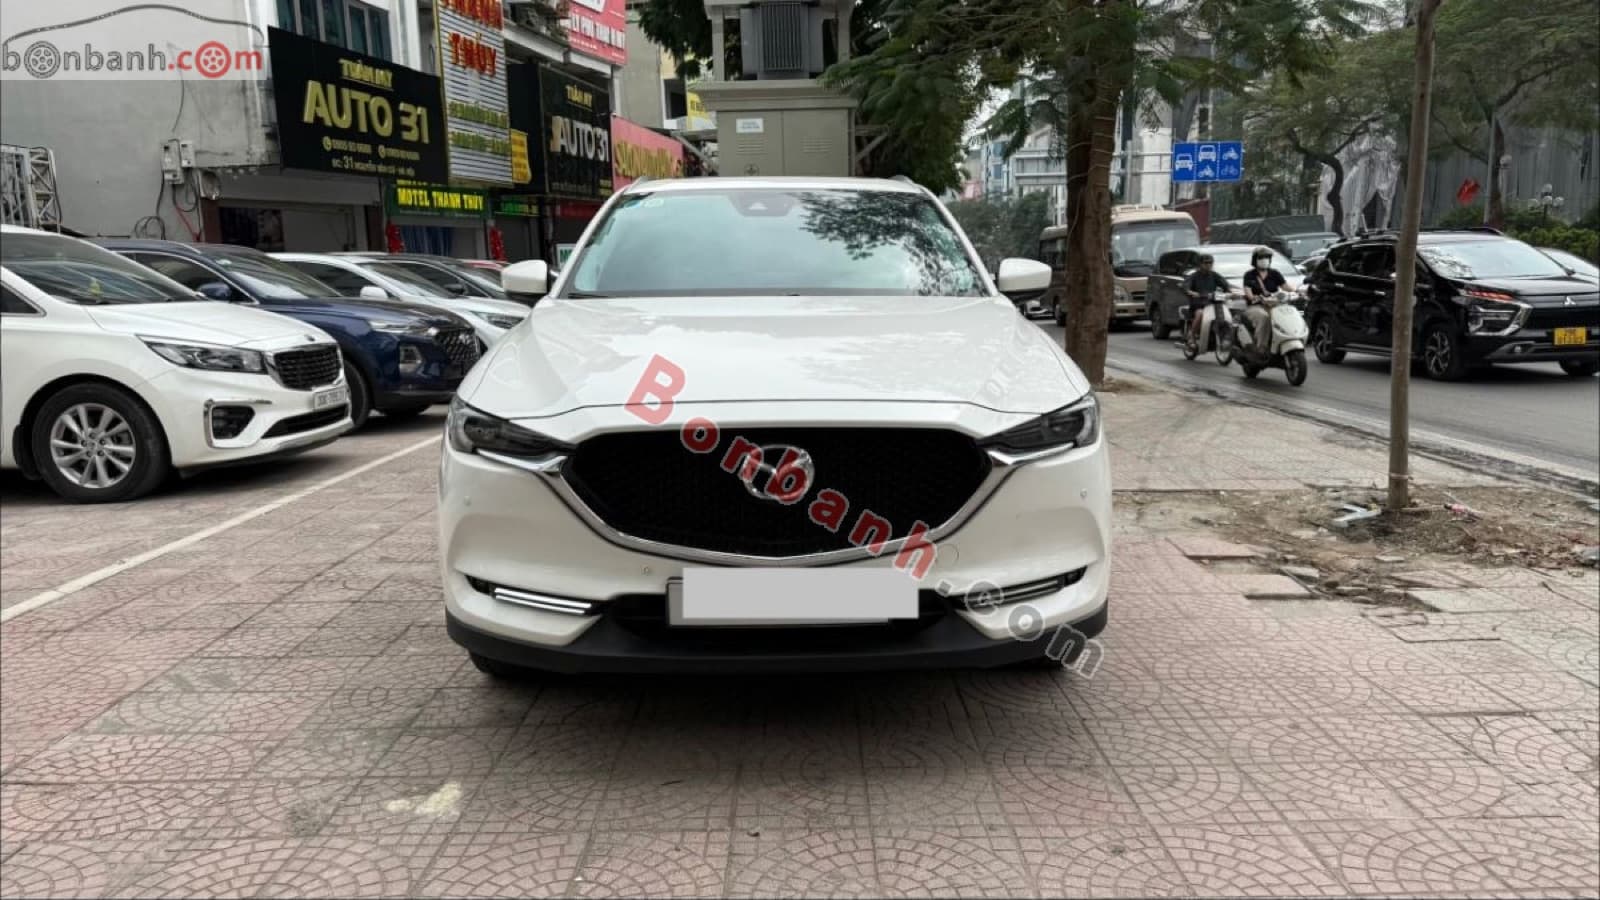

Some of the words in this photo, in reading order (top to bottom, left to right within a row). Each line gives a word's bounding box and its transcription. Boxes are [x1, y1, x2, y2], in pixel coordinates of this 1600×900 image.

[303, 80, 393, 137] AUTO
[398, 101, 429, 145] 31
[550, 115, 595, 160] AUTO
[396, 187, 430, 206] MOTEL
[432, 190, 461, 208] THANH
